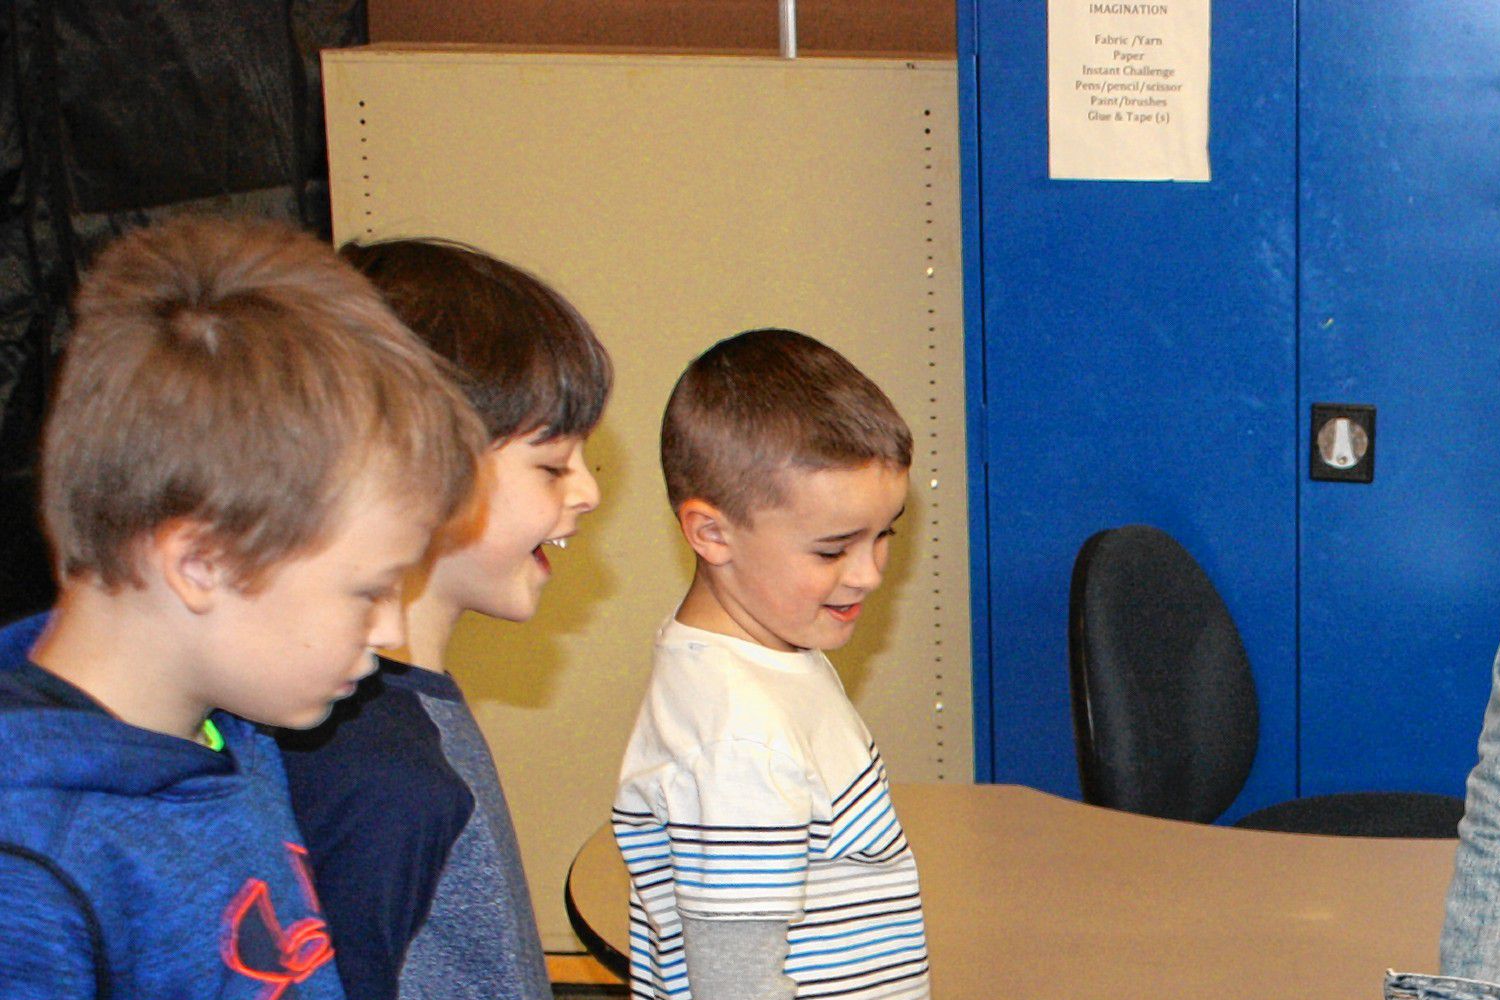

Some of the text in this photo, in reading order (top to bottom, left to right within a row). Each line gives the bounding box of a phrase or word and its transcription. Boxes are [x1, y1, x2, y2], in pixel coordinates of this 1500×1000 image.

[1089, 4, 1168, 15] IMAGINATION
[1094, 34, 1163, 47] Fabric /Yarn
[1113, 50, 1145, 62] Paper
[1082, 65, 1175, 78] Instant Challenge
[1075, 80, 1183, 94] Pens/pencil/scissor
[1090, 95, 1168, 108] Paint/brushes
[1087, 110, 1170, 124] Glue & Tape (s)
